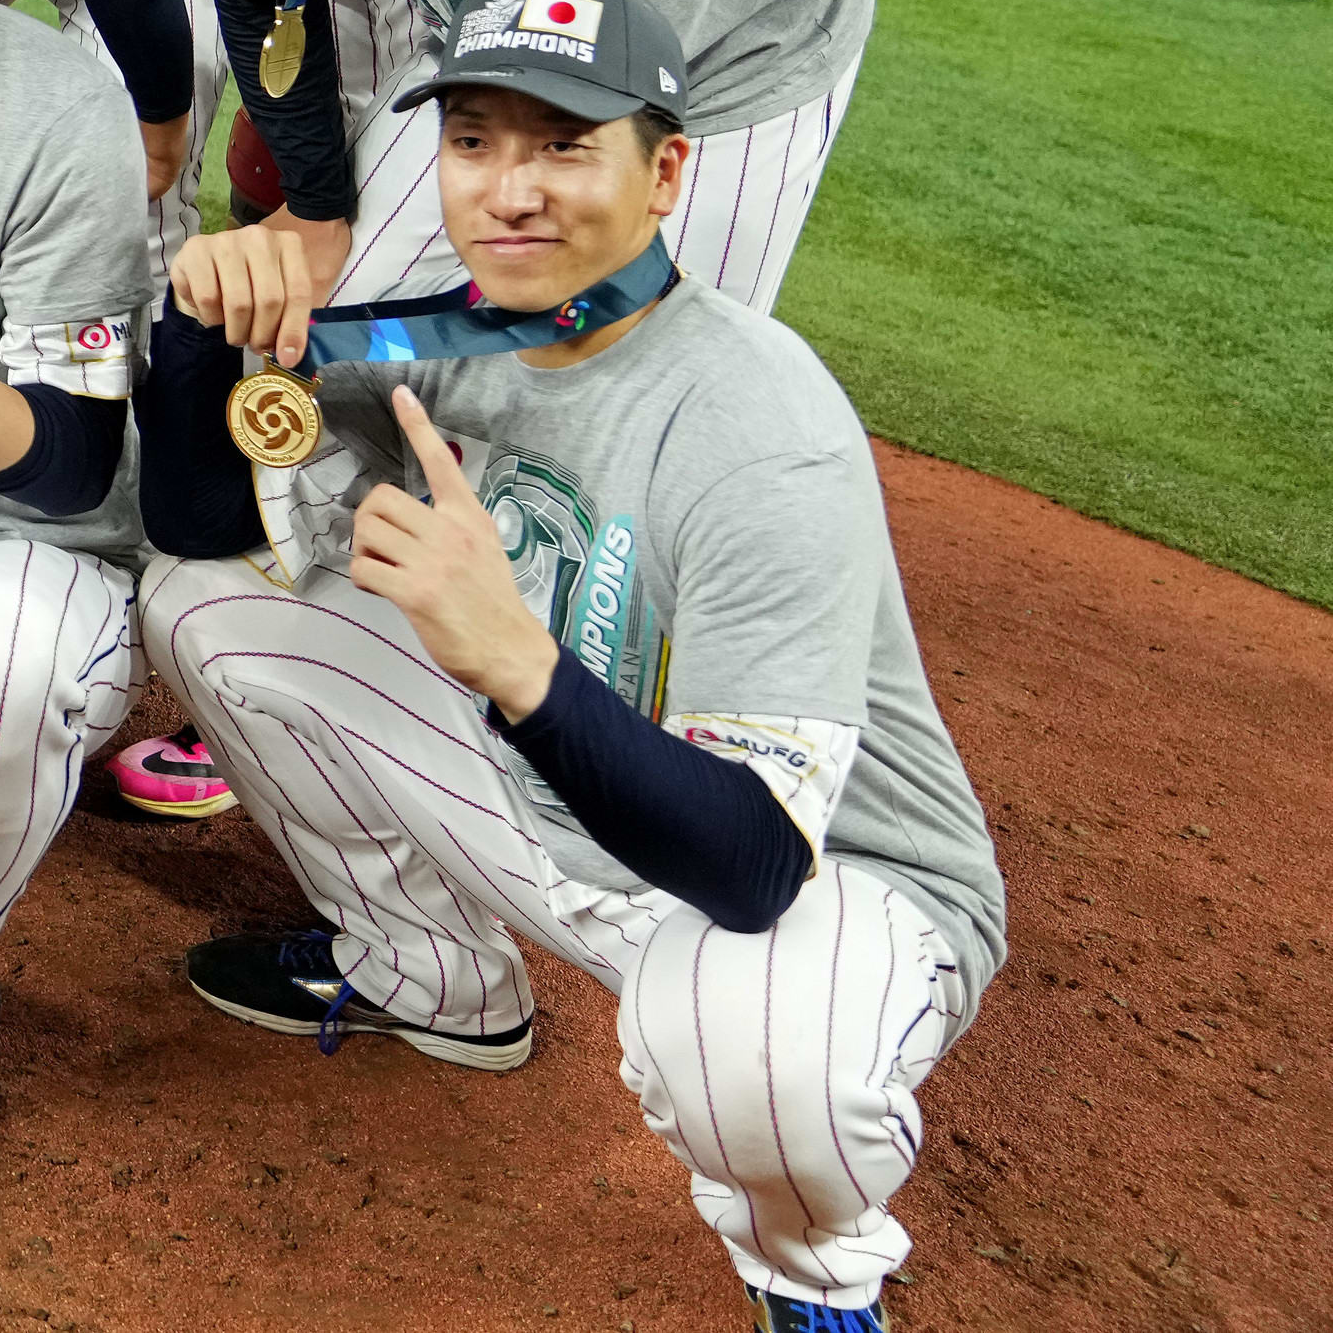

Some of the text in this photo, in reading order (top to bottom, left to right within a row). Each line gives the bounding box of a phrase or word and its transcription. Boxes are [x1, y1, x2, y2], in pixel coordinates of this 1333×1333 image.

[454, 32, 595, 63] CHAMPIONS
[579, 522, 633, 685] MPIONS
[726, 733, 807, 769] MUFG
